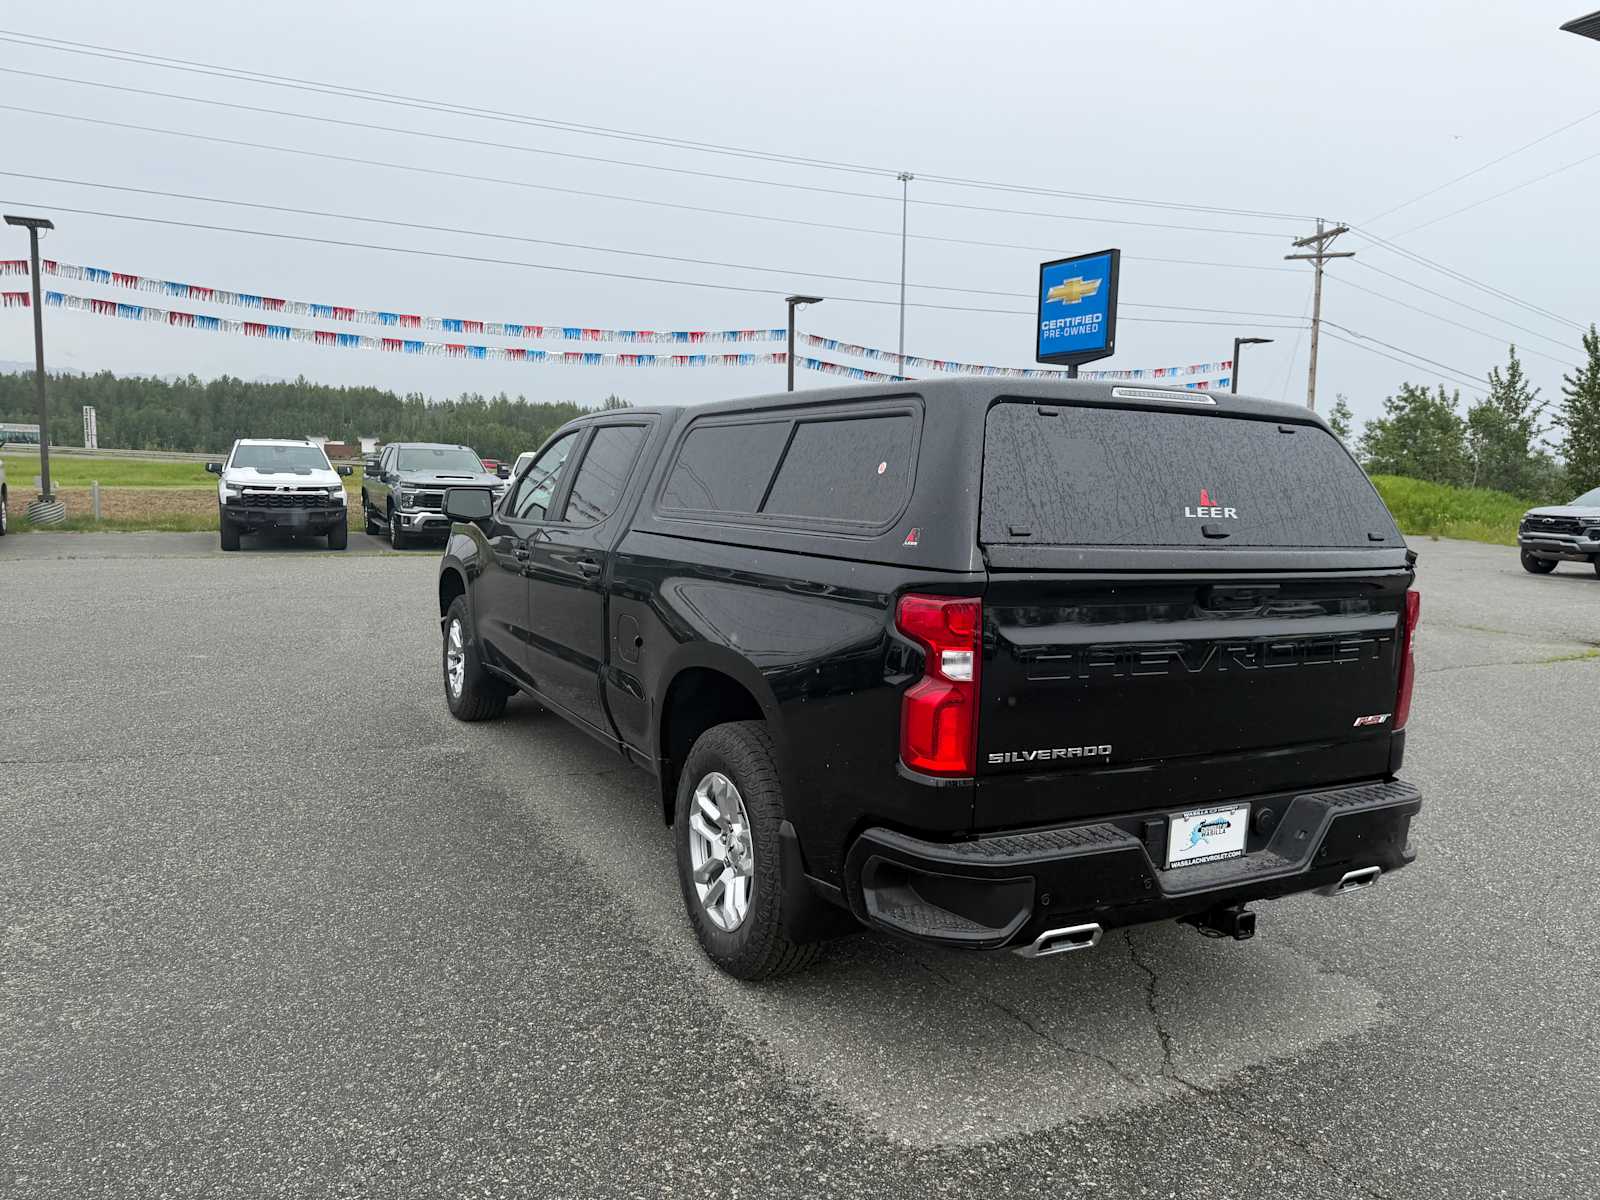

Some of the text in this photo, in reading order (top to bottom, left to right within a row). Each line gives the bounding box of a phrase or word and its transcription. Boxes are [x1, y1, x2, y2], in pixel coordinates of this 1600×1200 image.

[1041, 313, 1102, 330] CERTIFIED
[1043, 323, 1098, 339] PRE-OWNED
[1184, 506, 1239, 519] LEER
[1025, 634, 1391, 681] CHEVROLET
[1353, 713, 1392, 727] RST
[987, 744, 1112, 764] SILVERADO
[1170, 851, 1241, 869] WASILLACHEVROLET.COM
